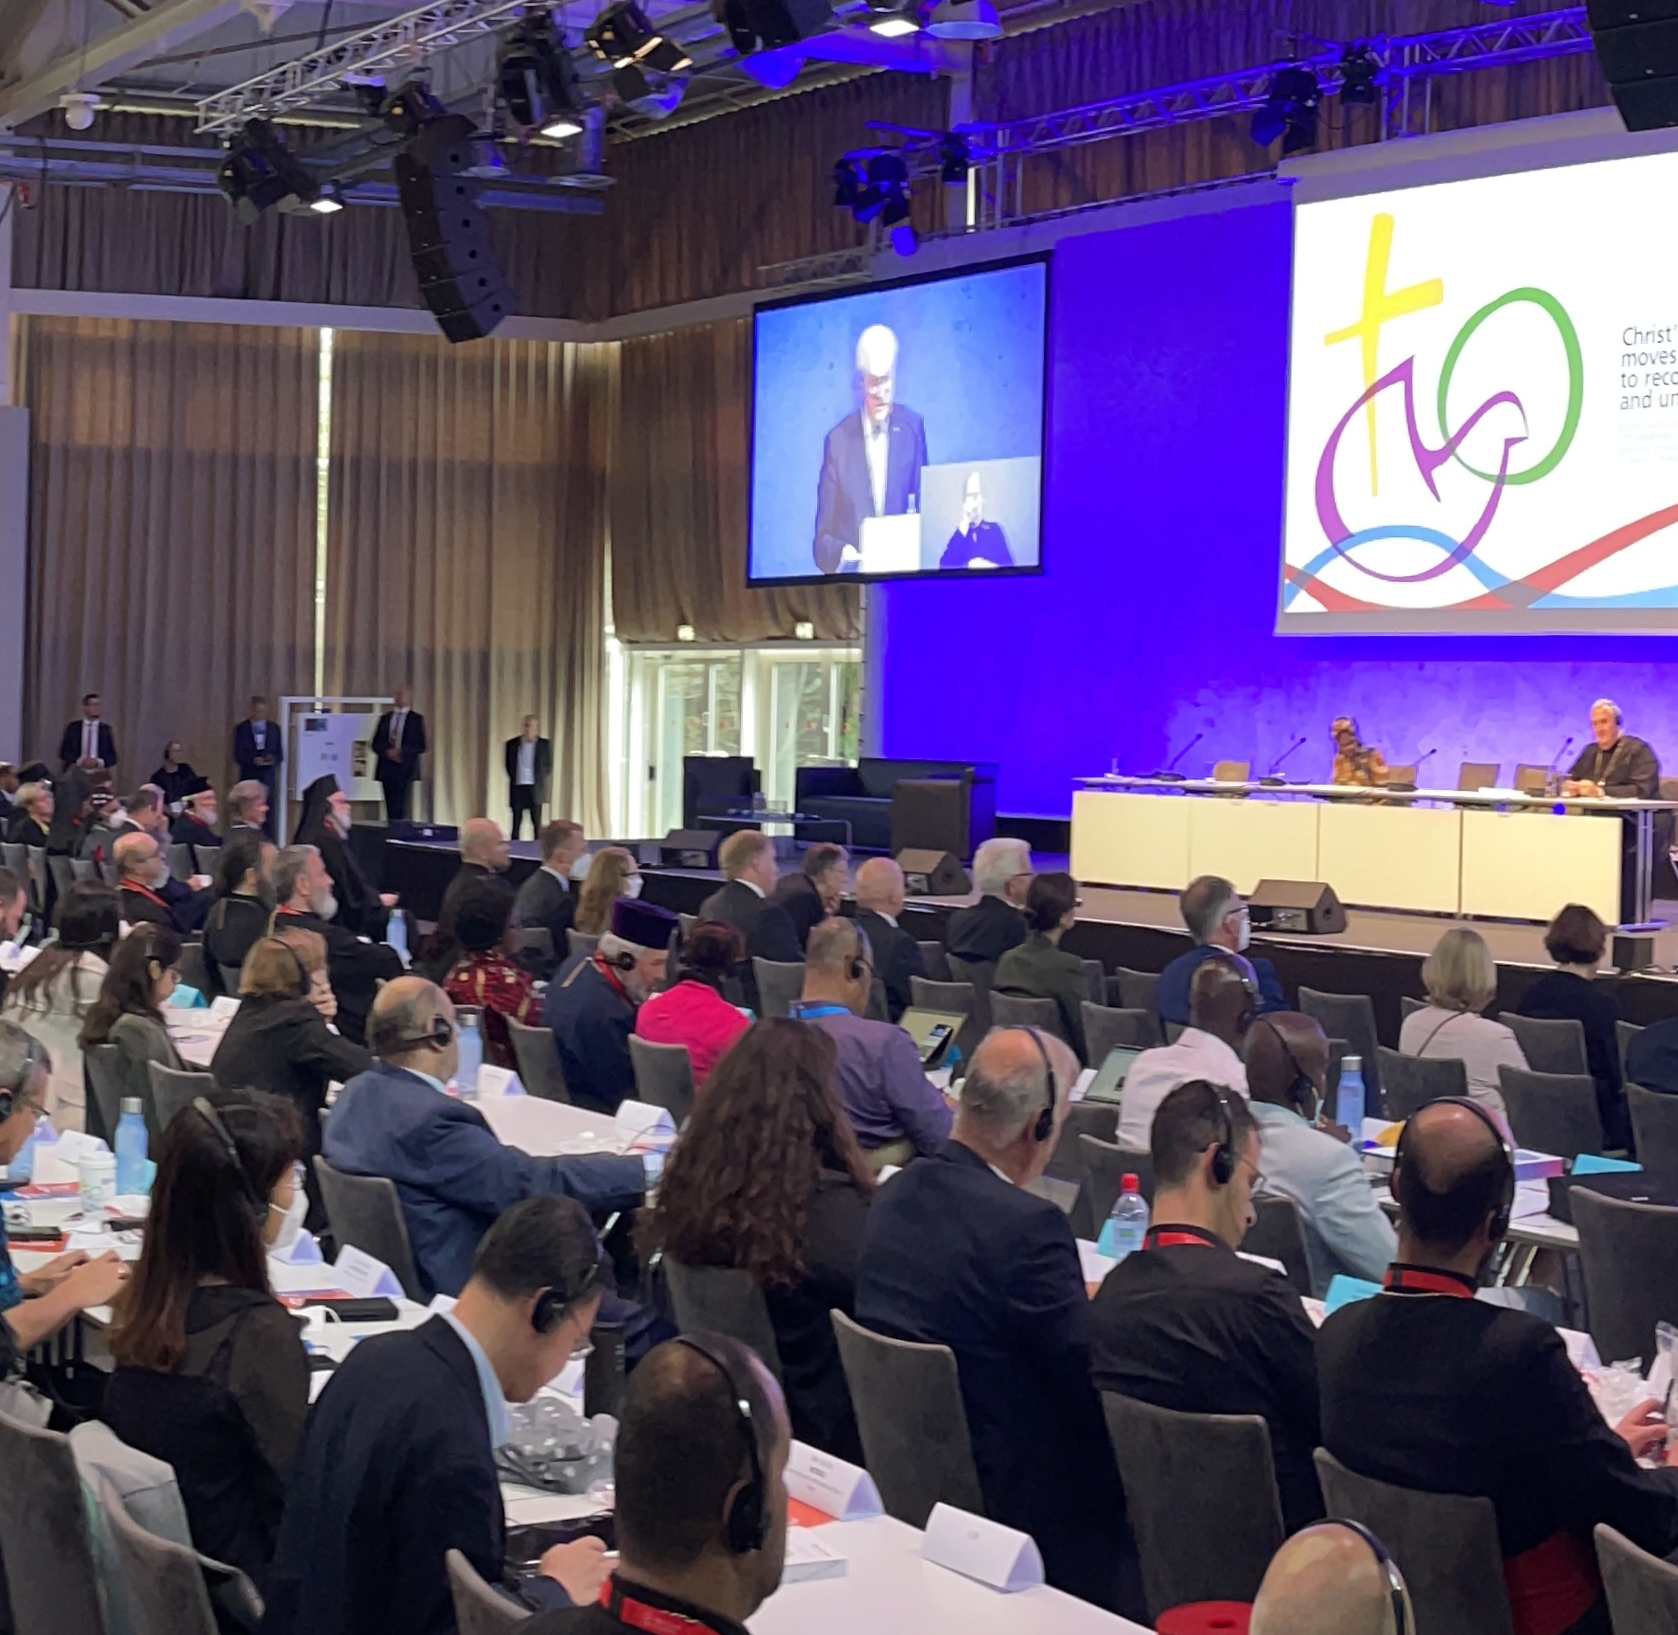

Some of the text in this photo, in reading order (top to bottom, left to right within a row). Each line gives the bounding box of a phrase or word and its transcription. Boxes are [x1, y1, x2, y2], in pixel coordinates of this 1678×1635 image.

[1621, 349, 1677, 367] moves
[1621, 373, 1639, 389] to
[1620, 388, 1653, 410] and
